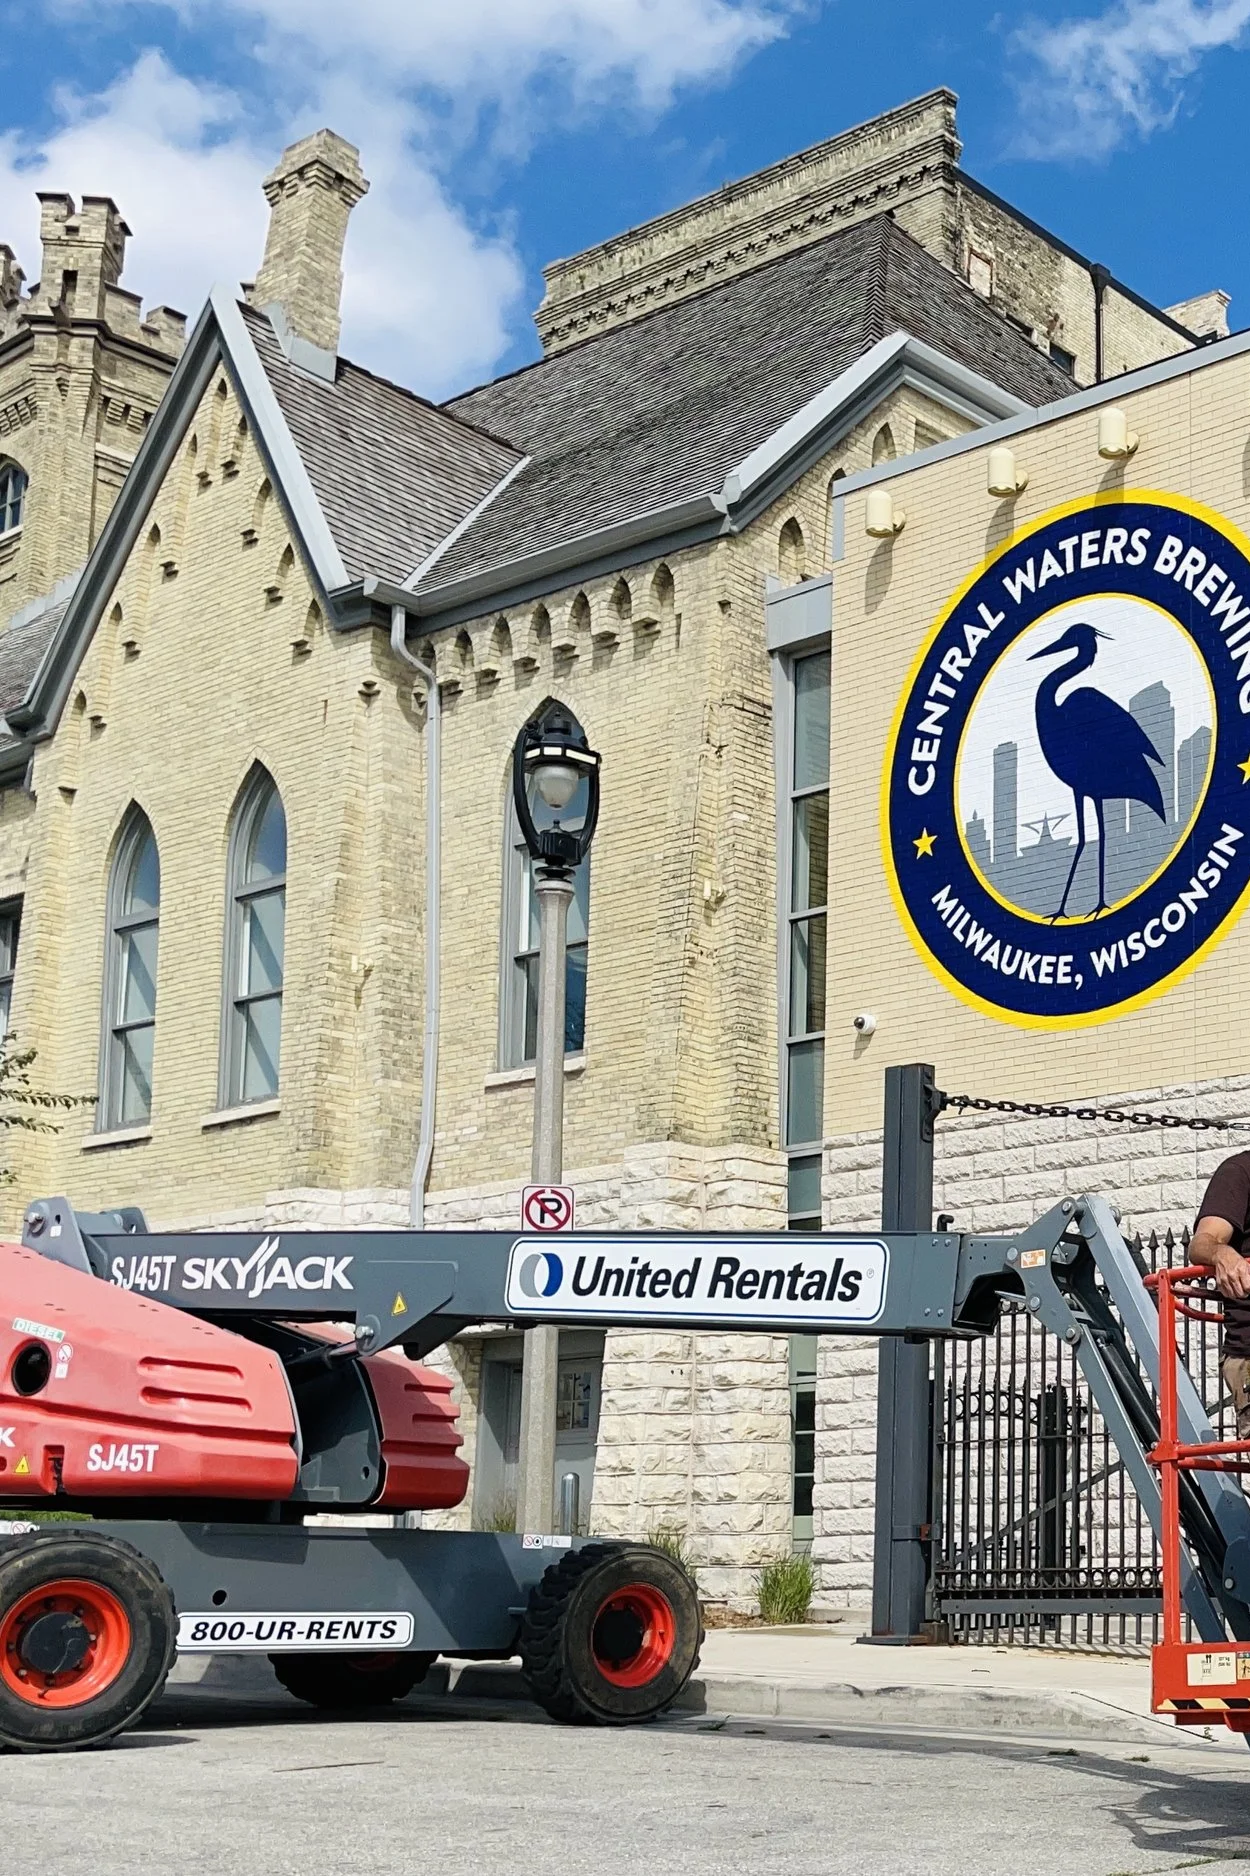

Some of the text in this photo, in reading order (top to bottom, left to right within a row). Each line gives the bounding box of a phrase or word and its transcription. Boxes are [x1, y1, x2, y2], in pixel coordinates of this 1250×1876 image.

[908, 603, 1005, 796] CENTRAL
[1002, 526, 1151, 604] WATERS
[931, 822, 1245, 990] MILWAUKEE, WISCONSIN
[111, 1235, 354, 1298] SJ45T SKYJACK
[572, 1256, 862, 1302] United Rentals
[87, 1443, 159, 1472] SJ45T
[190, 1619, 397, 1641] 800-UR-RENTS
